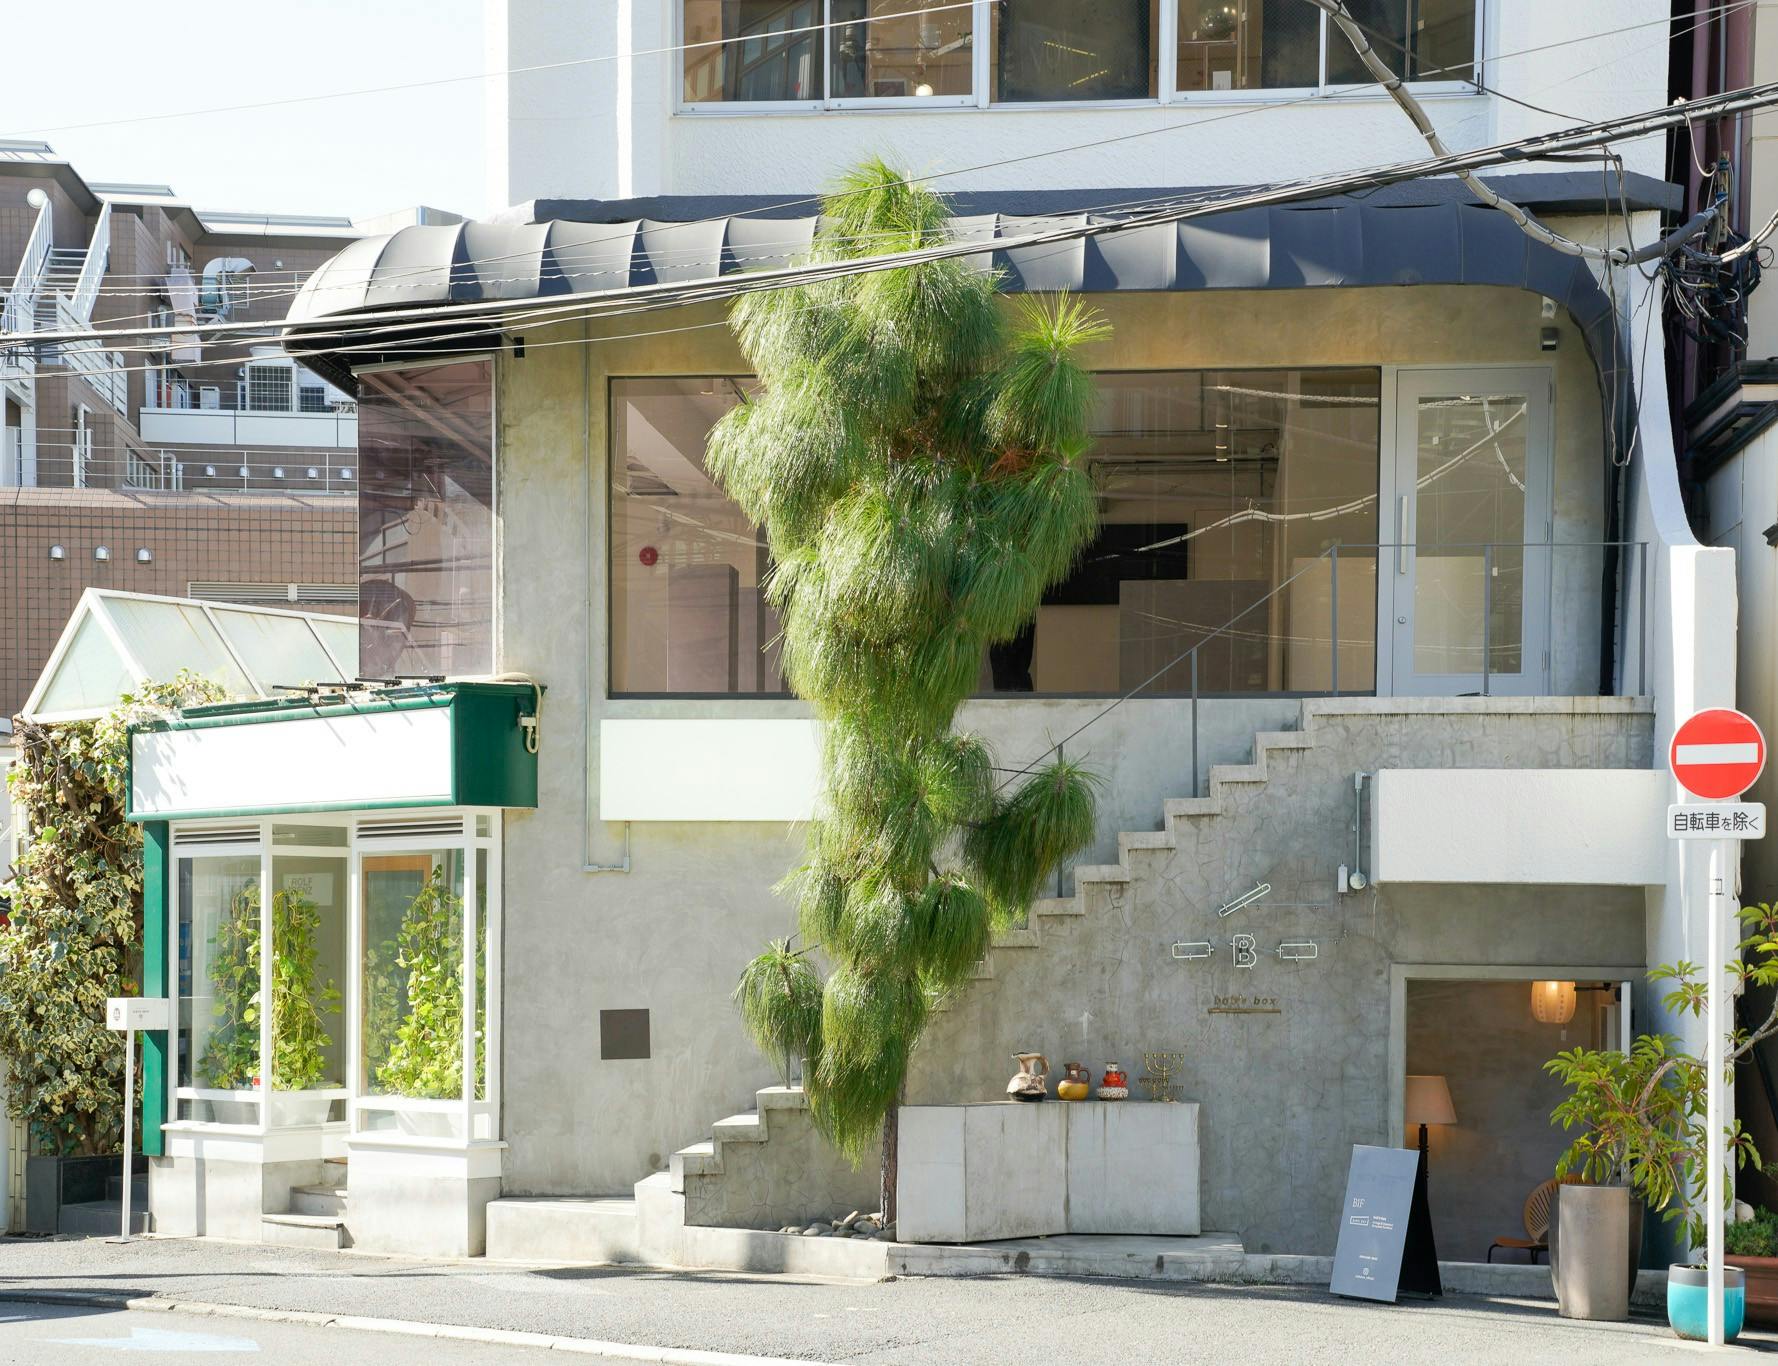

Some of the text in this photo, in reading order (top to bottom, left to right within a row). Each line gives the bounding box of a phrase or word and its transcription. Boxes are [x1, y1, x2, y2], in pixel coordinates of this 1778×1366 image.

[1674, 811, 1759, 832] 自転車を除く
